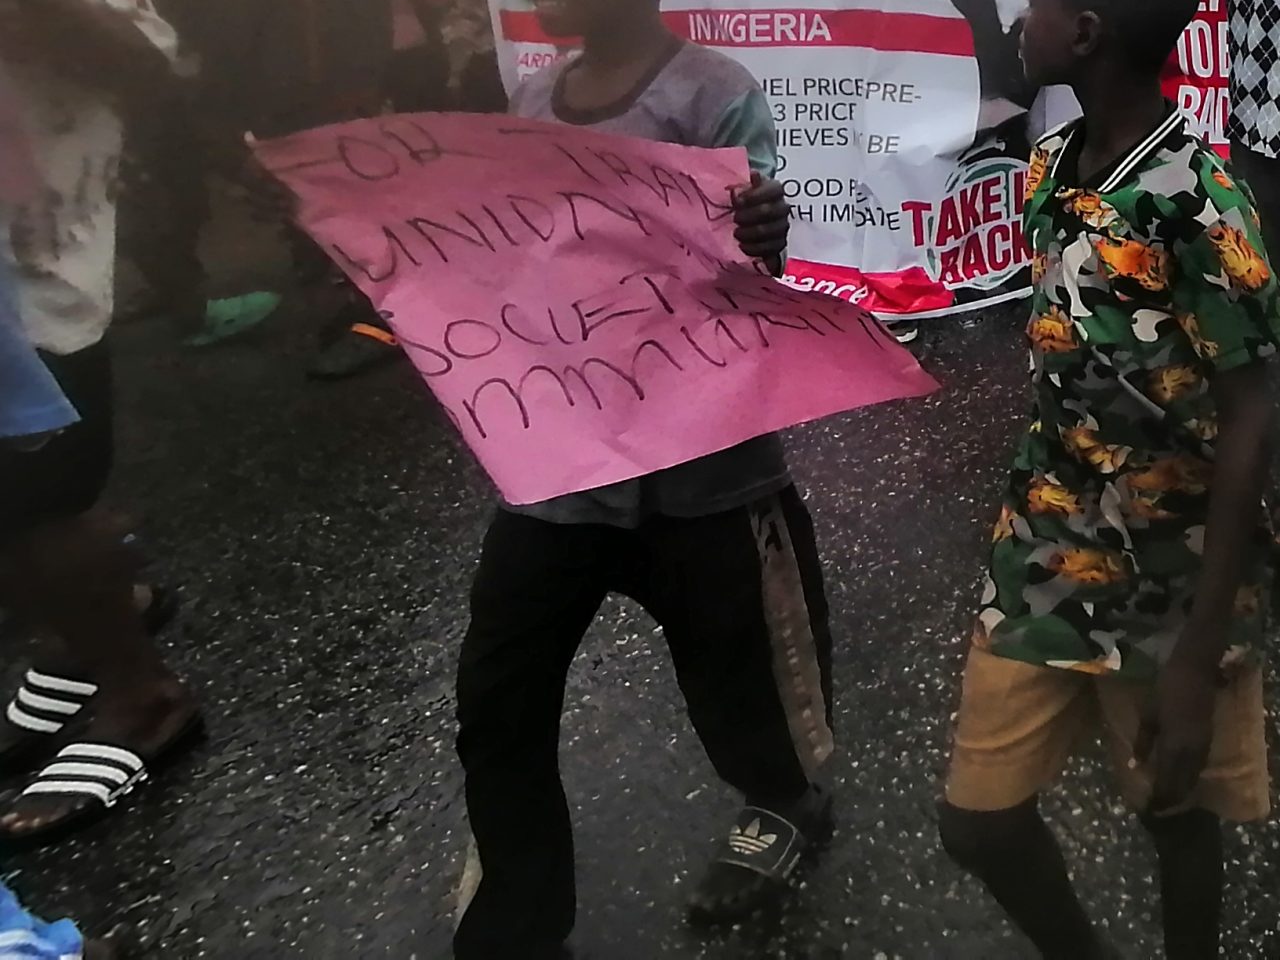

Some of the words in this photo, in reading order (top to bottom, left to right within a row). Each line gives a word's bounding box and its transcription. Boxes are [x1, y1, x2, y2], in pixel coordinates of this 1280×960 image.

[865, 82, 922, 103] PRE-
[867, 134, 899, 154] BE
[783, 178, 843, 198] OOD
[902, 175, 1002, 246] TAKE
